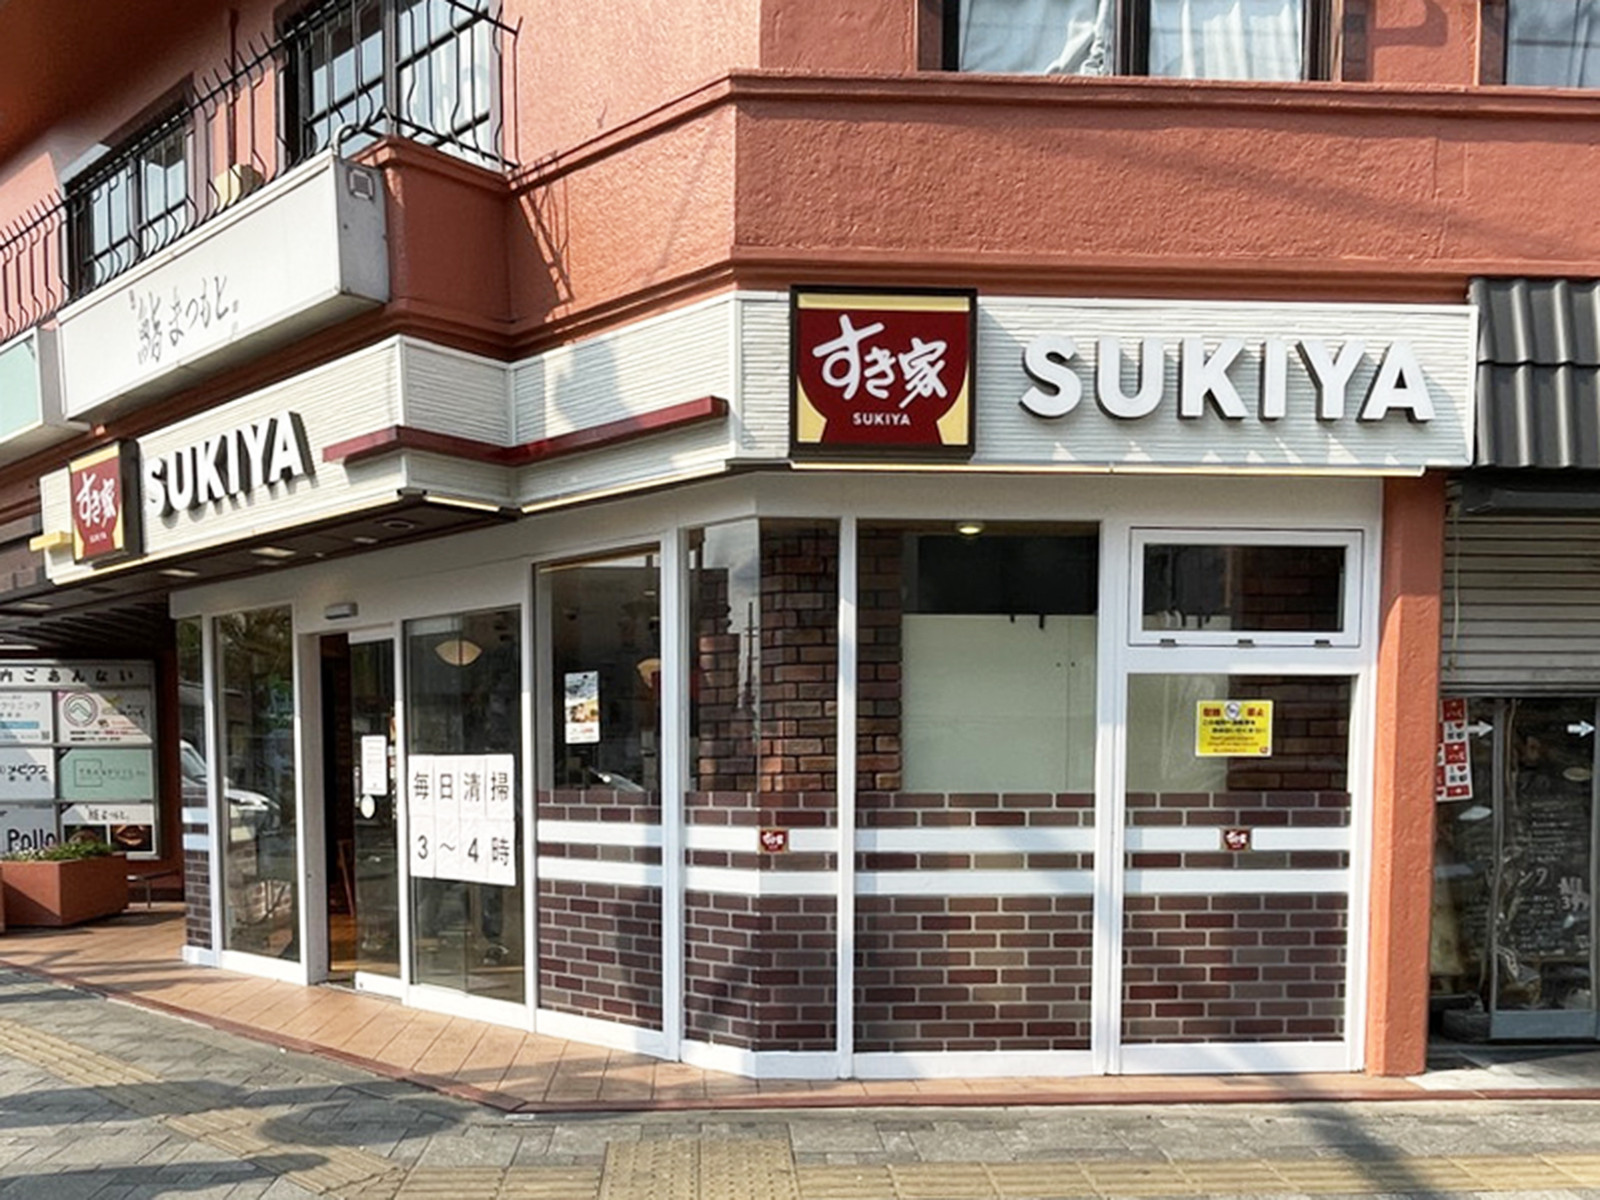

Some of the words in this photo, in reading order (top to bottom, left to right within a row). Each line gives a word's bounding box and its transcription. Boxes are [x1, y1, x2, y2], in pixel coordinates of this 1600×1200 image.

[812, 314, 948, 409] すき家
[1019, 334, 1436, 421] SUKIYA
[852, 412, 911, 426] SUKIYA
[76, 471, 117, 528] すき家
[144, 409, 308, 518] SUKIYA
[413, 770, 510, 802] 毎日清掃
